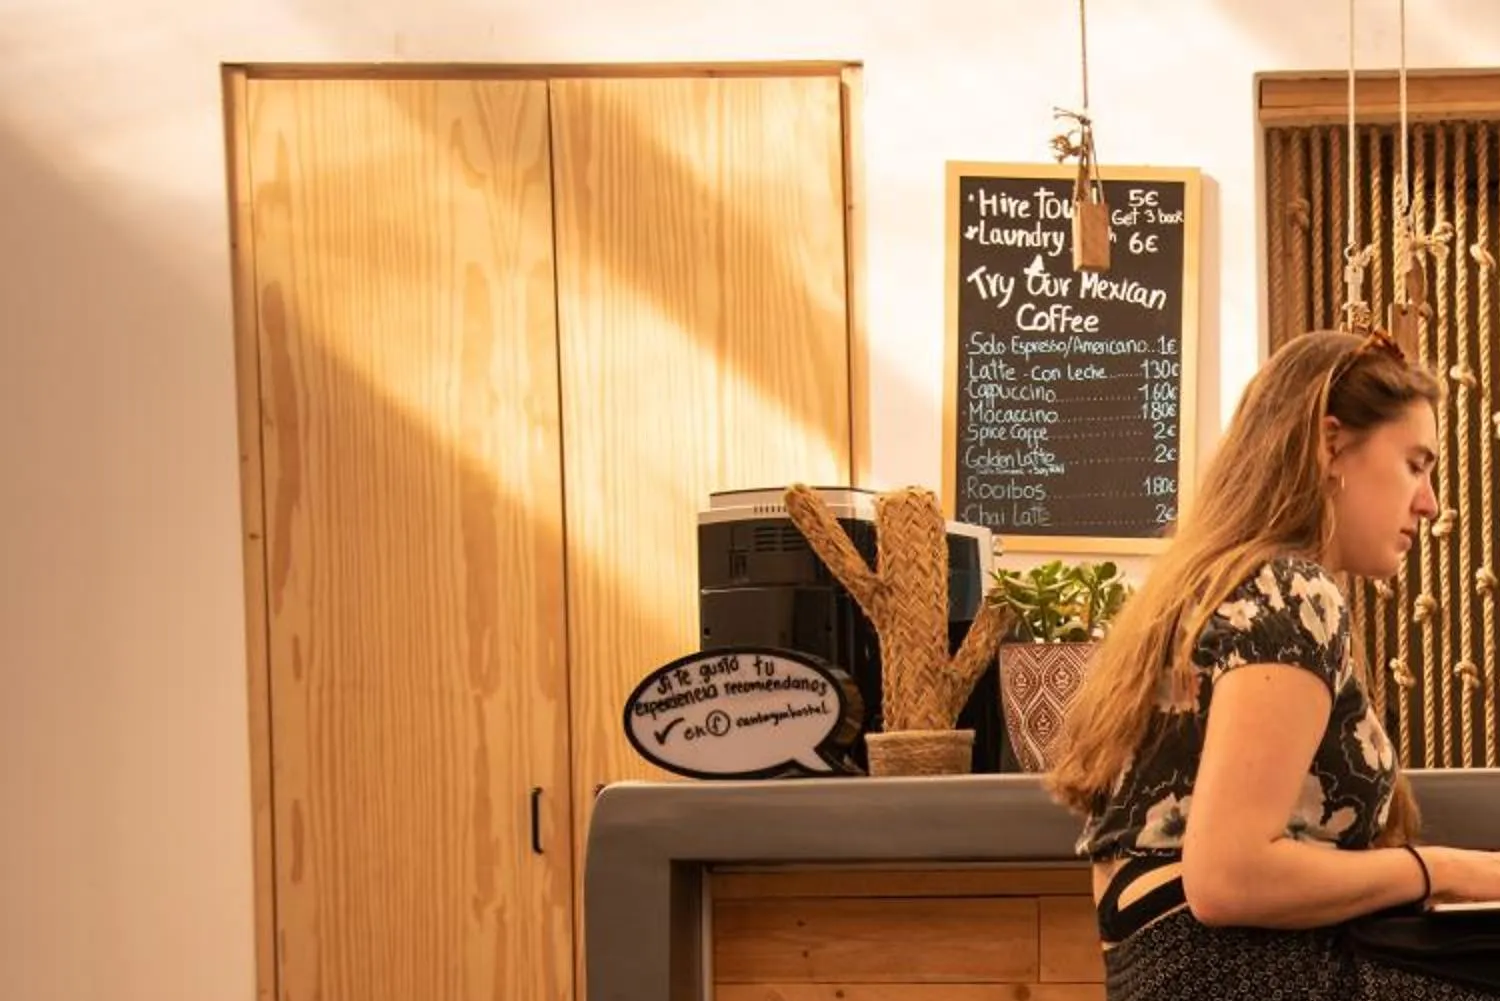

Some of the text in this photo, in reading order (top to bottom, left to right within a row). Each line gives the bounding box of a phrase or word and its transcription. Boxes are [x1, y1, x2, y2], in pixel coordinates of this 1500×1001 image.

[979, 189, 1031, 219] Hire
[1128, 189, 1159, 207] 5€
[1112, 209, 1139, 226] Get
[1145, 210, 1156, 224] 3
[979, 220, 1065, 256] Laundry
[1129, 232, 1159, 254] 6€
[967, 266, 1014, 308] Try
[1080, 270, 1167, 310] Mexican
[967, 332, 1006, 355] Solo
[969, 357, 1017, 381] Latte
[1153, 421, 1177, 440] 2€
[967, 477, 1047, 501] Rooibos
[753, 655, 775, 677] tu
